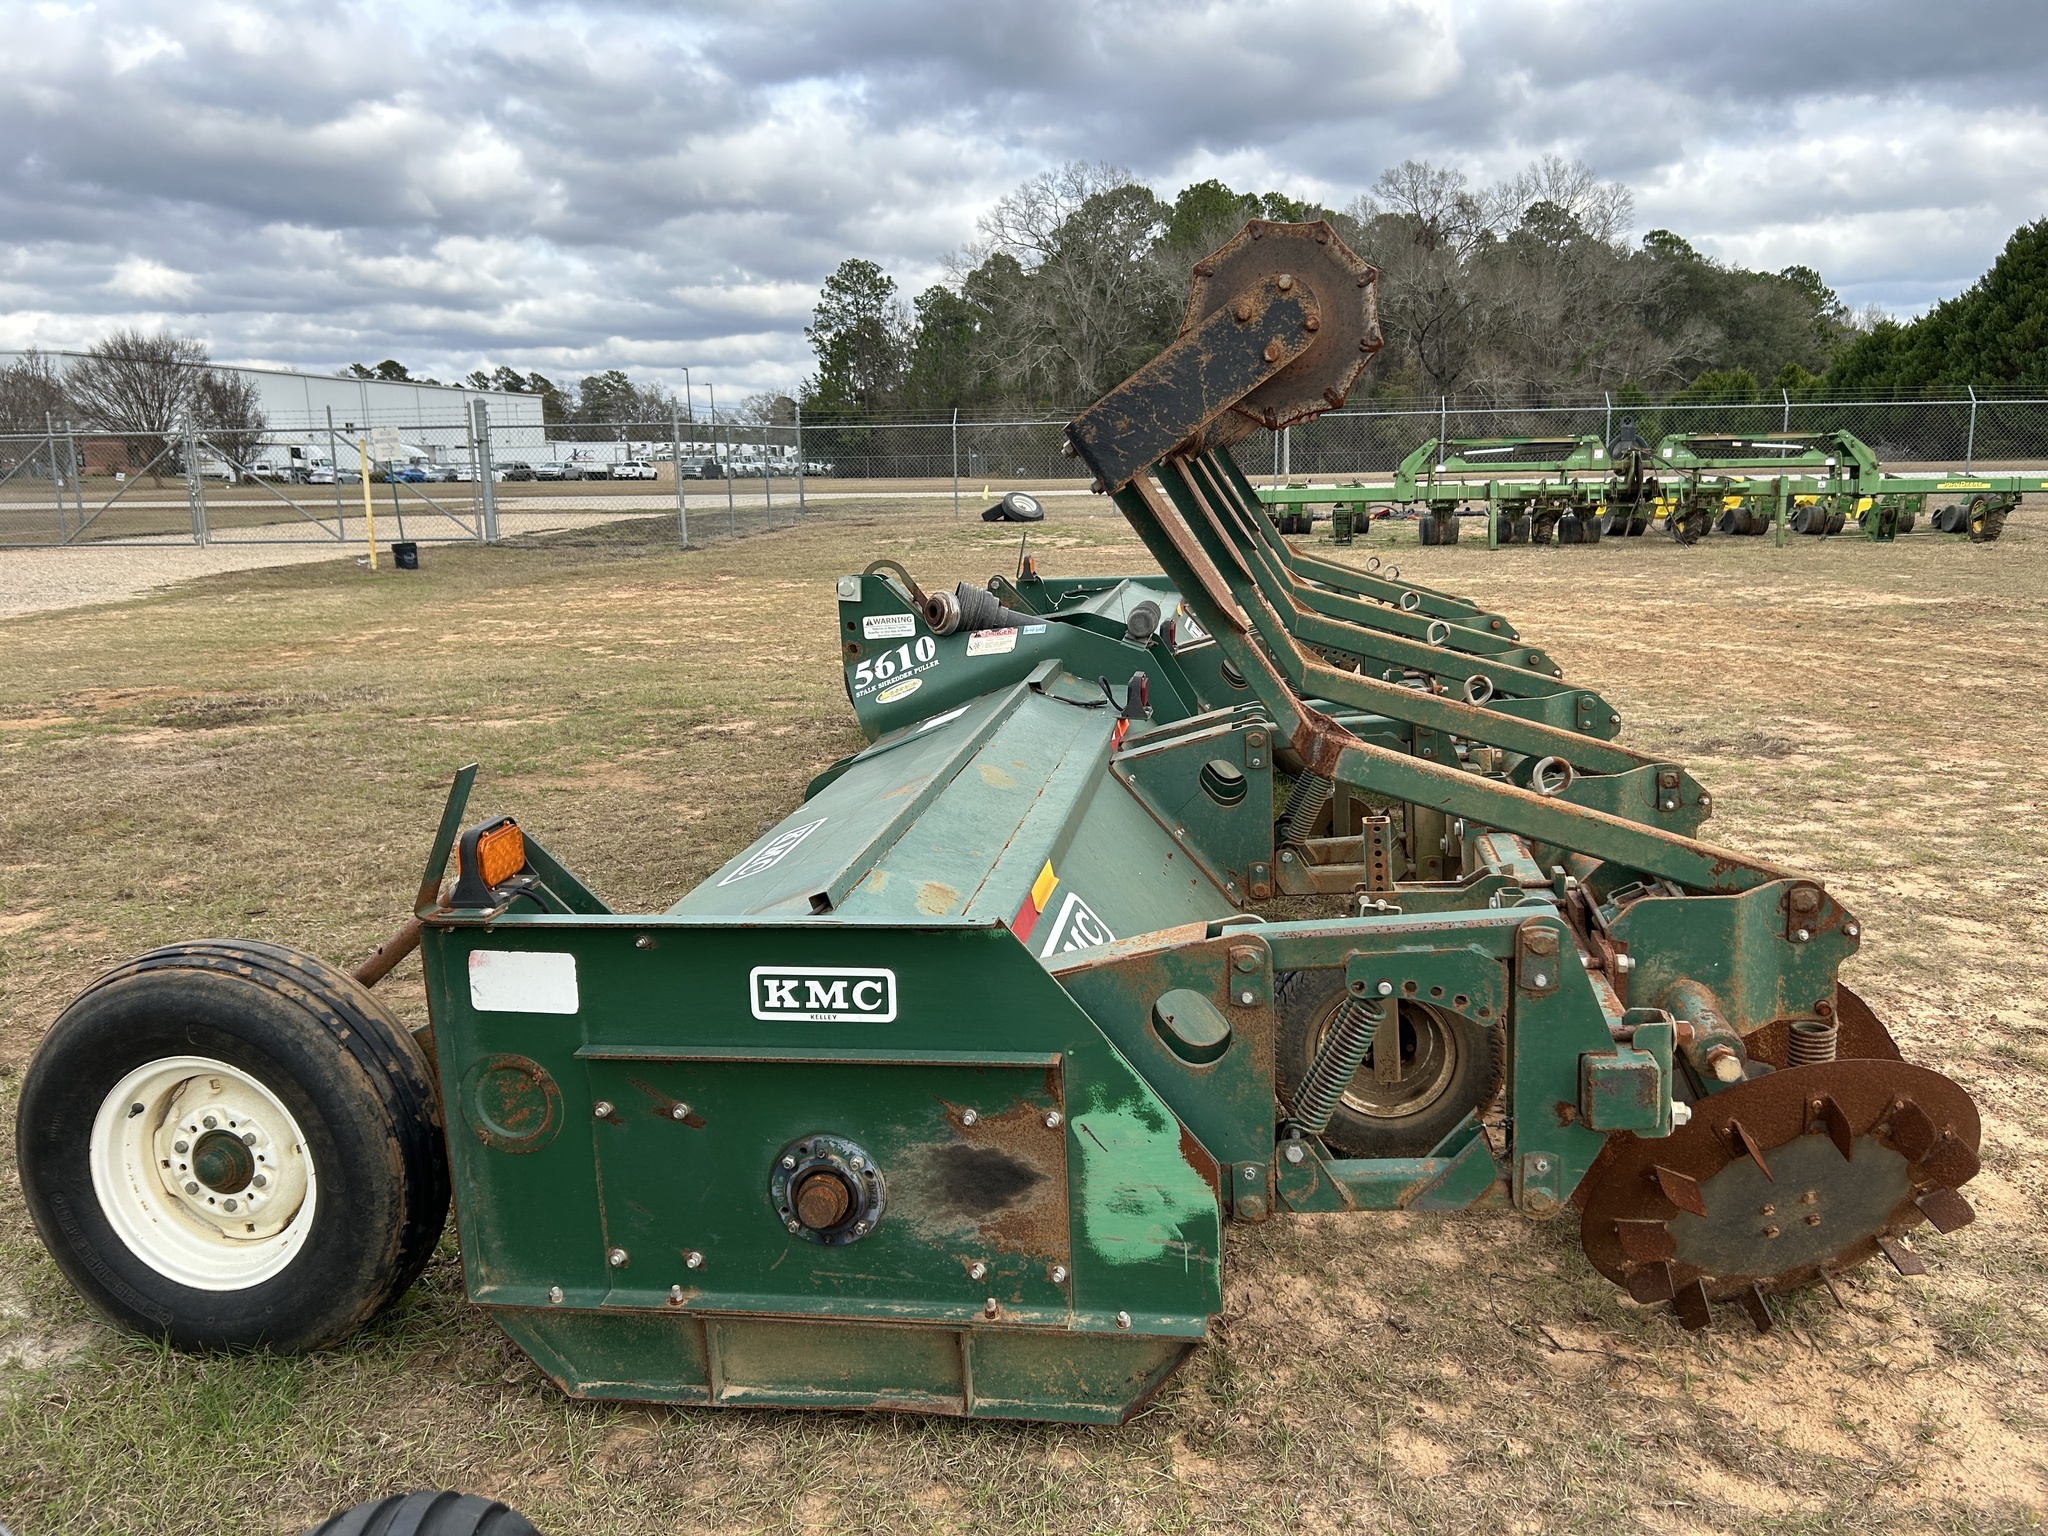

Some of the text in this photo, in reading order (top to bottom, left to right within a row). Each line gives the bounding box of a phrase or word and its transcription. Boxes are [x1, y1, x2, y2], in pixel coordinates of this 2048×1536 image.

[873, 616, 913, 625] WARNING
[985, 629, 1013, 637] DANGER
[854, 635, 936, 690] 5610
[855, 685, 877, 698] STALK
[877, 671, 913, 689] SHREDDER
[913, 660, 940, 675] PULLER
[763, 979, 882, 1011] KMC
[810, 1013, 838, 1021] KELLEY
